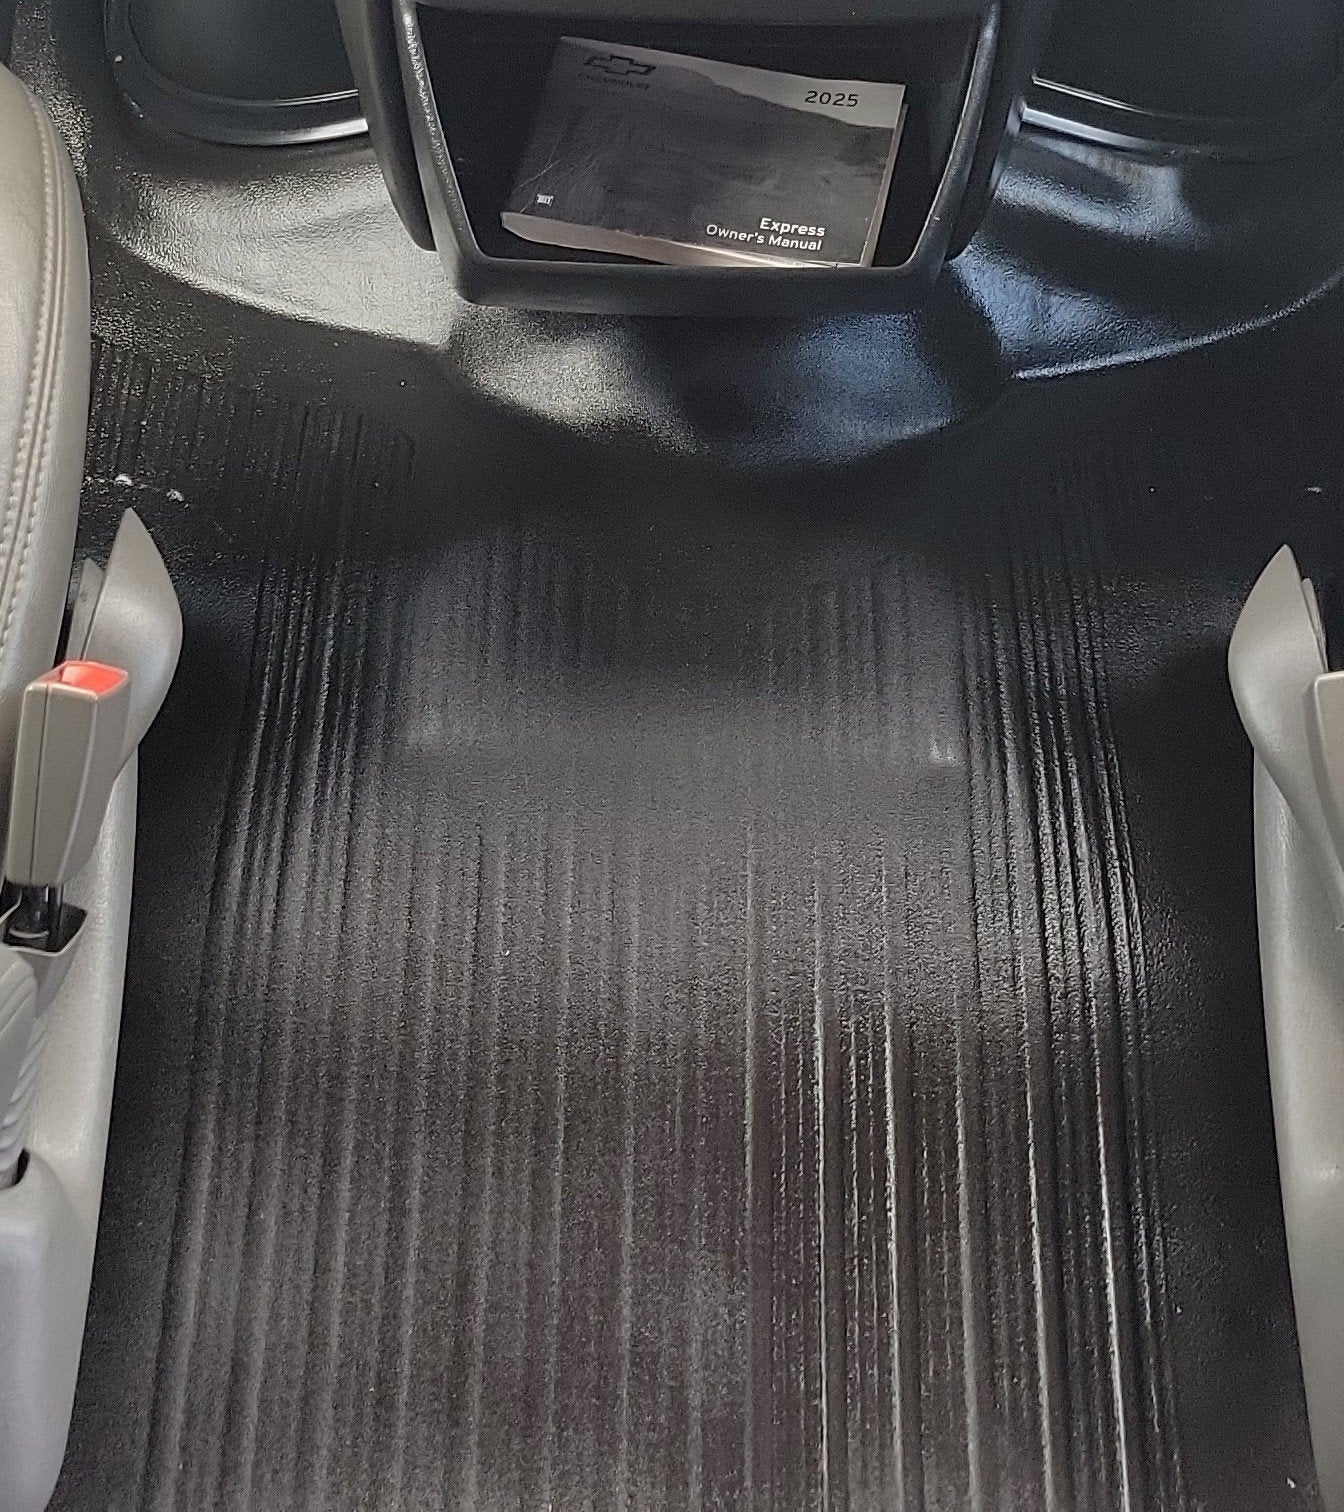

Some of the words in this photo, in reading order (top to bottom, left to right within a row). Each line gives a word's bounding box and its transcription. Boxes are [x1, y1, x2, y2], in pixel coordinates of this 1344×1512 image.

[804, 90, 859, 107] 2025
[759, 217, 826, 237] Express
[706, 224, 765, 244] Owner's
[768, 234, 822, 251] Manual
